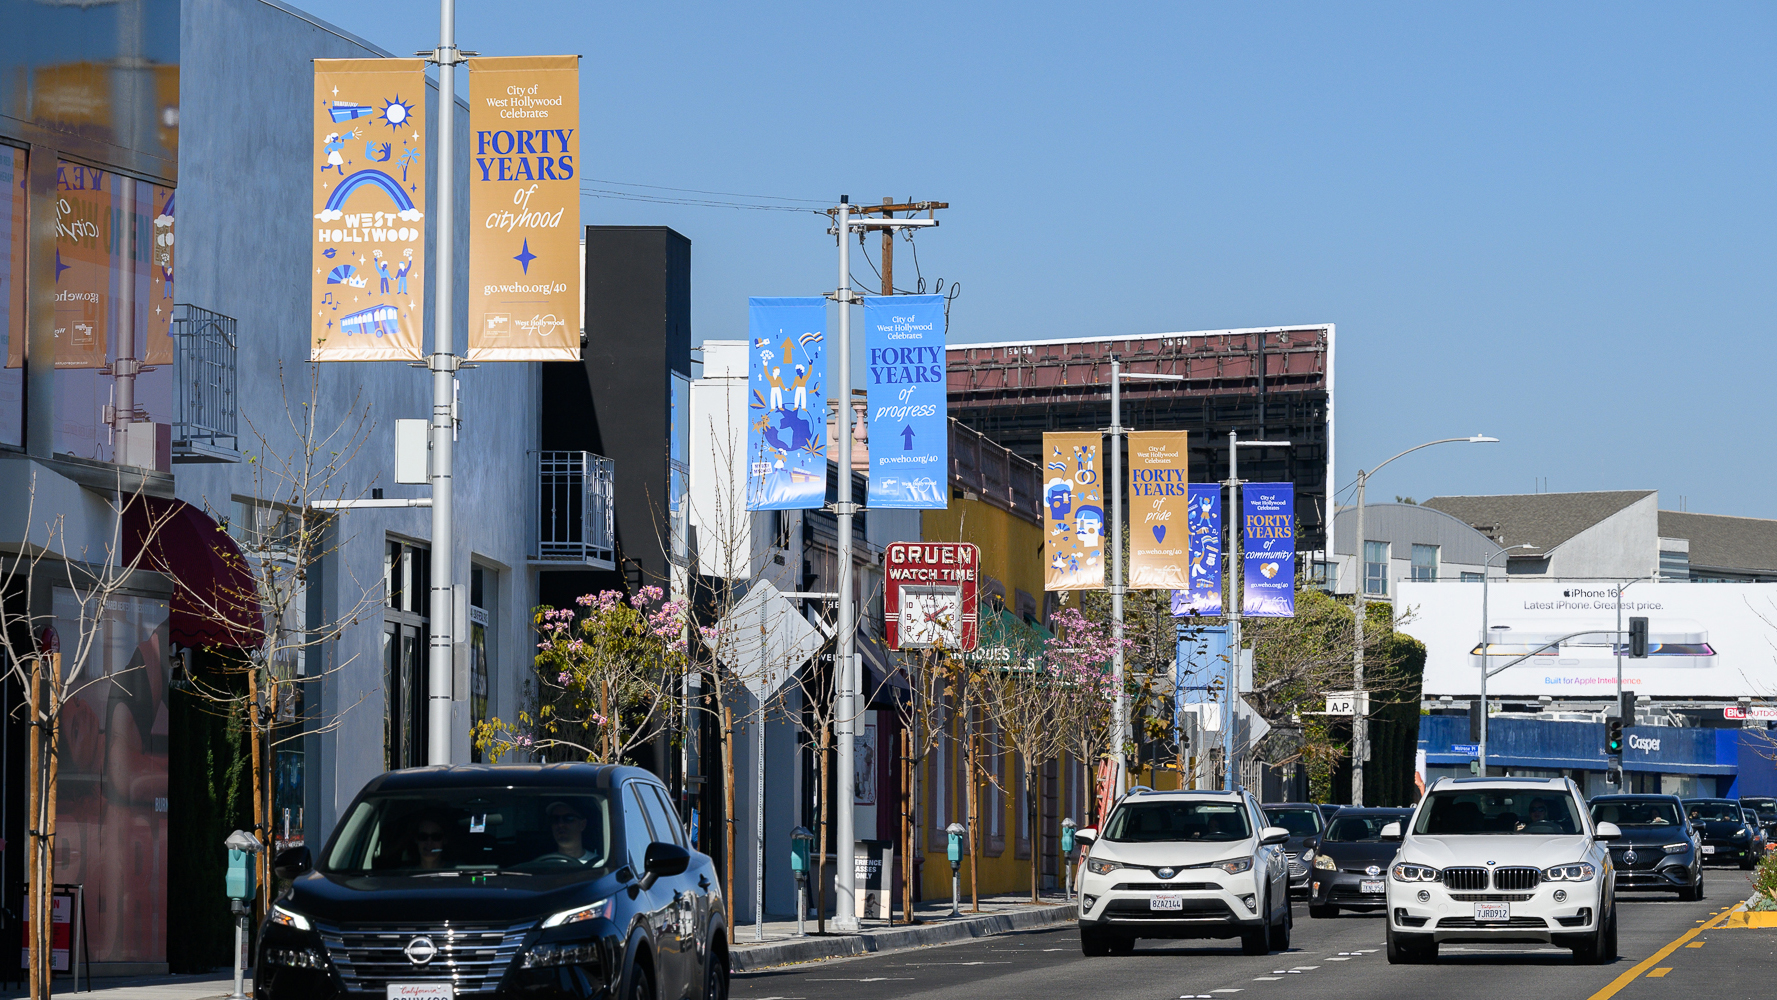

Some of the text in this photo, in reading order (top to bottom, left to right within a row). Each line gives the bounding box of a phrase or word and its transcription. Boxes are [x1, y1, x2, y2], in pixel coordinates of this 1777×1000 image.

[507, 84, 538, 95] City of
[486, 96, 562, 109] West Hollywood
[500, 108, 549, 118] Celebrates
[477, 129, 574, 155] FORTY
[476, 156, 574, 182] YEARS
[514, 184, 538, 209] of
[345, 211, 397, 228] WEST
[486, 207, 564, 232] cityhood
[319, 227, 419, 243] HOLLYWOOD
[484, 282, 567, 296] go.weho.org/40
[515, 319, 529, 327] West
[892, 315, 915, 324] City of
[877, 323, 932, 333] West Hollywood
[888, 332, 922, 340] Celebrates
[870, 346, 942, 365] FORTY
[870, 365, 942, 384] YEARS
[899, 386, 916, 404] of
[874, 404, 936, 422] progress
[879, 455, 938, 465] go.weho.org/40
[1151, 451, 1179, 459] Hollywood
[1132, 468, 1185, 483] FORTY
[1132, 483, 1185, 497] YEARS
[1153, 497, 1166, 511] of
[1144, 510, 1171, 523] pride
[1246, 514, 1292, 527] FORTY
[1246, 526, 1292, 539] YEARS
[1263, 538, 1275, 551] of
[891, 546, 972, 565] GRUEN
[1137, 549, 1182, 557] go.weho.org/40
[1245, 550, 1293, 561] community
[889, 567, 975, 582] WATCH TIME
[1571, 588, 1605, 598] iPhone
[1524, 600, 1664, 613] Latest iPhone. Greaest price.
[906, 613, 912, 621] 9
[1544, 676, 1643, 687] Built for Apple Intellience.
[1332, 702, 1355, 713] A.P.
[1727, 708, 1745, 718] BIG
[1629, 734, 1660, 751] Casper
[1477, 909, 1507, 919] 7JRD912
[401, 987, 438, 997] California
